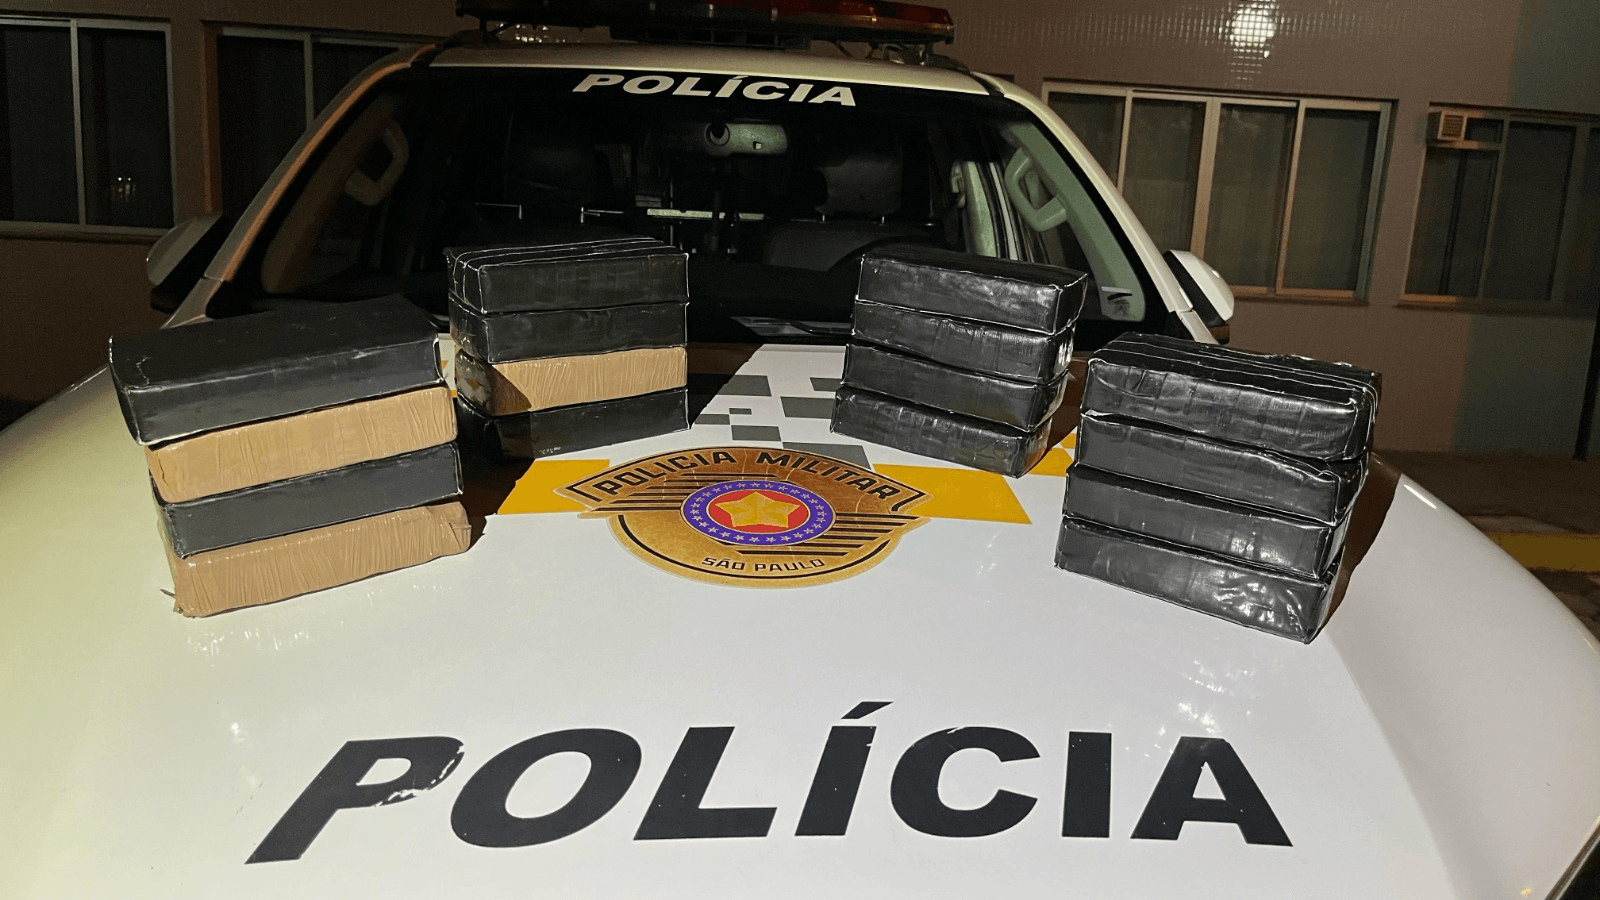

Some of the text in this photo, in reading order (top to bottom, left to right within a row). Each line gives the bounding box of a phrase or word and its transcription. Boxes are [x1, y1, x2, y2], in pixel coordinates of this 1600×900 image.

[572, 74, 856, 106] POLÍCIA
[592, 451, 901, 499] POLICIA MILITAR
[702, 557, 825, 571] SÃO PAULO
[245, 701, 1293, 864] POLÍCIA
